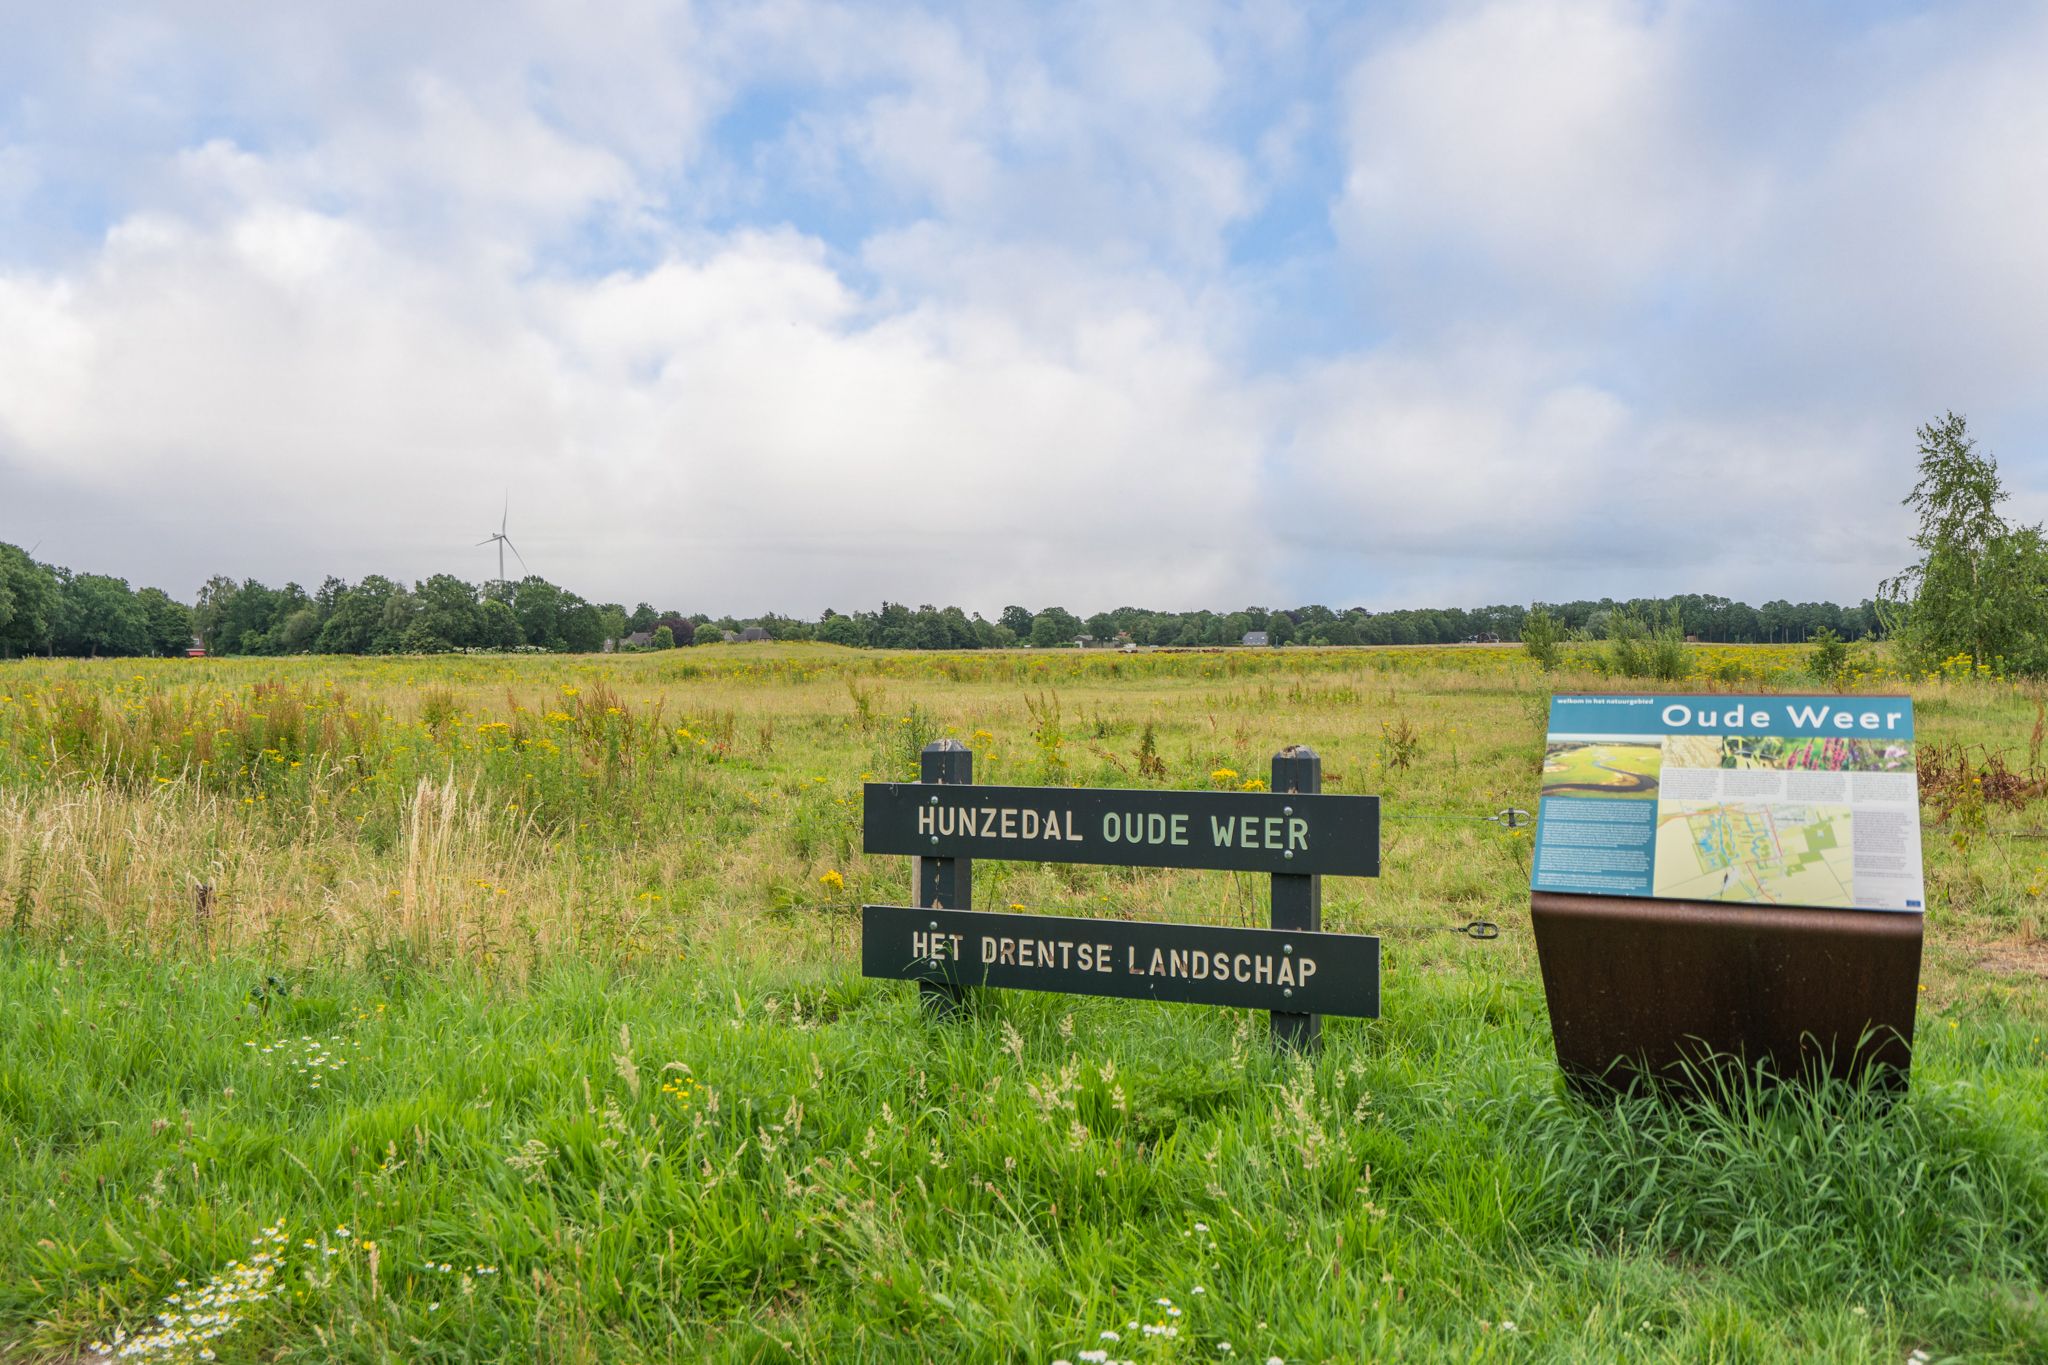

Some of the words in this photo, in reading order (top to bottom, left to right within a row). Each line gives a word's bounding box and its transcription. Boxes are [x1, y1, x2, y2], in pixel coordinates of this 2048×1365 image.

[1557, 697, 1584, 705] welkom
[1585, 697, 1592, 705] in
[1593, 697, 1605, 705] het
[1606, 698, 1654, 706] natuurgebied
[1662, 704, 1770, 728] Oude
[1786, 705, 1902, 730] Weer
[917, 805, 1083, 841] HUNZEDAL
[1103, 811, 1190, 846] OUDE
[1210, 814, 1311, 851] WEER
[911, 931, 965, 961] HET
[981, 936, 1113, 973] DRENTSE
[1128, 945, 1317, 988] LANDSCHAP
